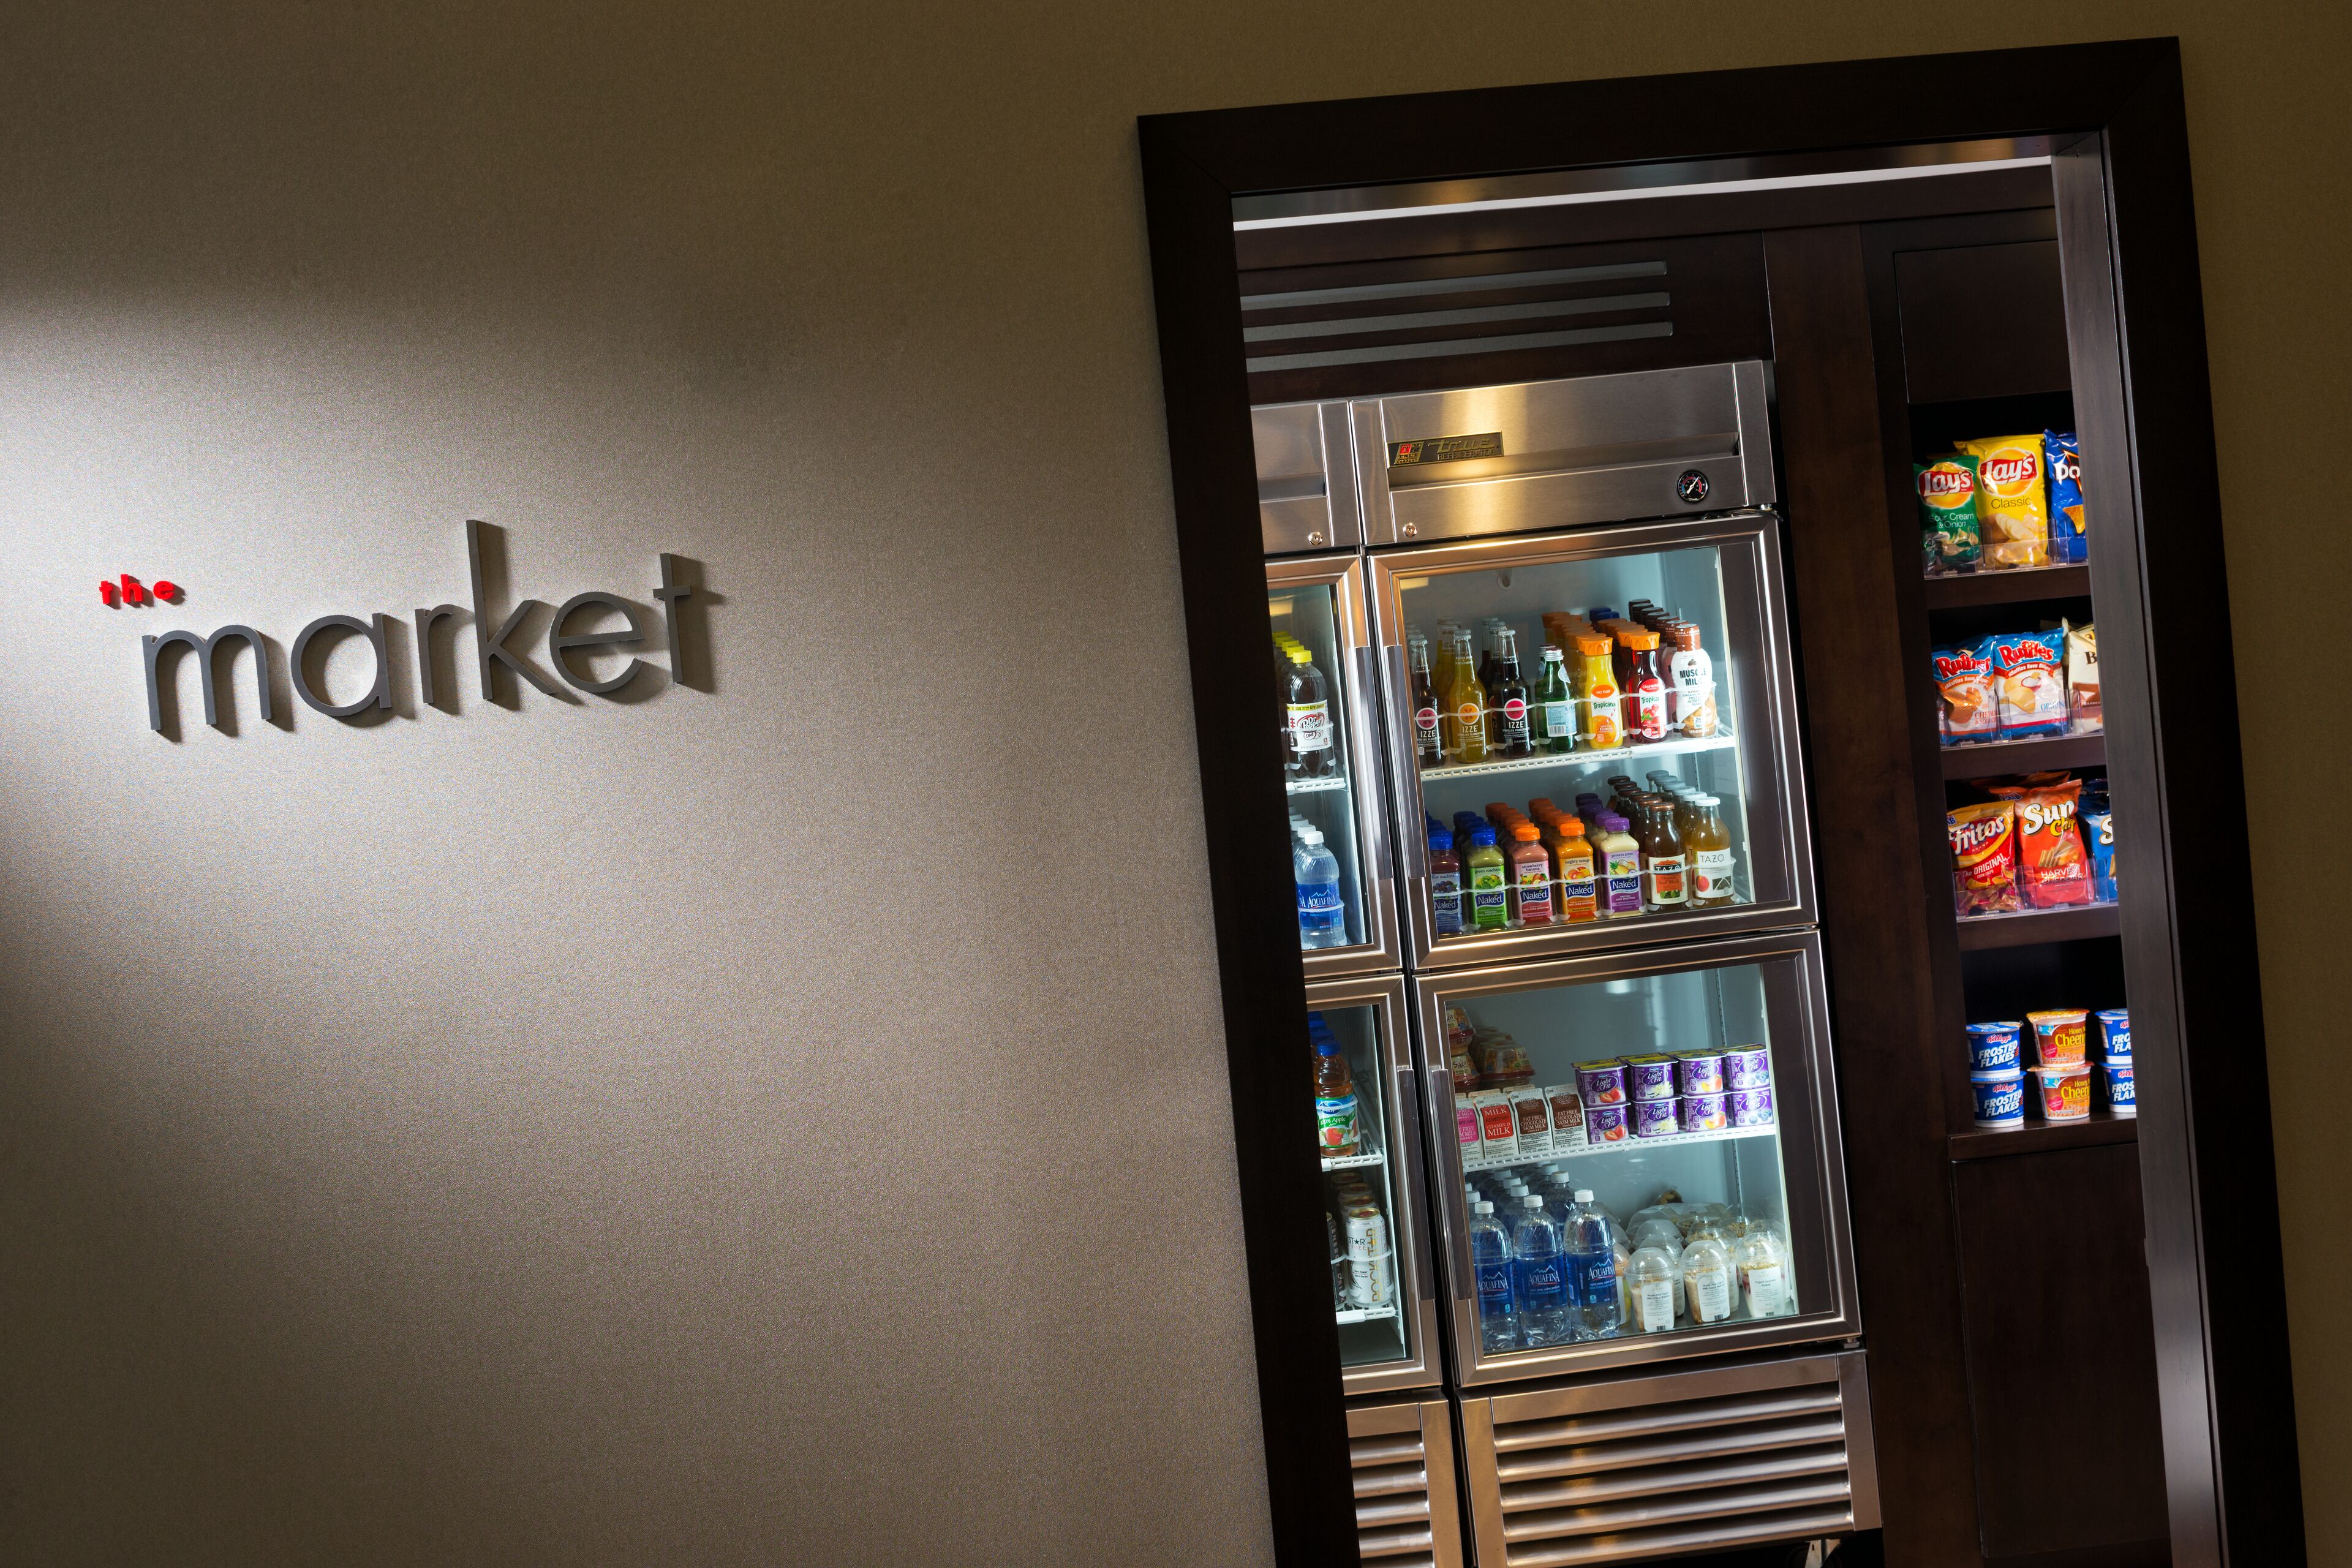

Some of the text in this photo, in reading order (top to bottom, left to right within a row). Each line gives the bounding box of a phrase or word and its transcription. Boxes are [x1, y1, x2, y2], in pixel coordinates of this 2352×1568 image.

[1437, 449, 1496, 461] REFRIGERATOR
[1986, 457, 2034, 484] Lay's
[1924, 472, 1971, 497] Lay's
[1991, 496, 2032, 509] Classic
[99, 573, 175, 605] the
[141, 519, 692, 731] market
[1997, 640, 2054, 668] Ruffles
[1679, 668, 1706, 678] MUSCE
[1303, 718, 1321, 729] Pepper
[2023, 800, 2075, 835] Sun
[1948, 816, 2005, 855] Fritos
[1700, 854, 1725, 863] TAZO
[1973, 853, 2007, 875] ORIGINAL
[1568, 885, 1593, 895] Naked
[1612, 880, 1637, 889] Naked
[1308, 894, 1336, 908] AQUAFINA
[1477, 895, 1502, 905] Naked
[1523, 890, 1548, 900] Naked
[1434, 900, 1456, 910] Naked
[1986, 1034, 2012, 1044] Kellogg's
[1978, 1040, 2018, 1060] FROSTED
[1980, 1050, 2015, 1069] FLAKES
[1647, 1071, 1663, 1079] Light
[1596, 1078, 1611, 1087] Light
[1992, 1083, 2017, 1093] Kellogg's
[1984, 1089, 2022, 1109] FROSTED
[1653, 1106, 1668, 1115] Light
[1986, 1098, 2020, 1118] FLAKES
[1555, 1113, 1581, 1121] CHOCOLATE
[1601, 1115, 1616, 1124] Light
[1488, 1127, 1511, 1137] MILK
[1477, 1276, 1509, 1291] AQUAFINA
[1529, 1270, 1560, 1285] AQUAFINA
